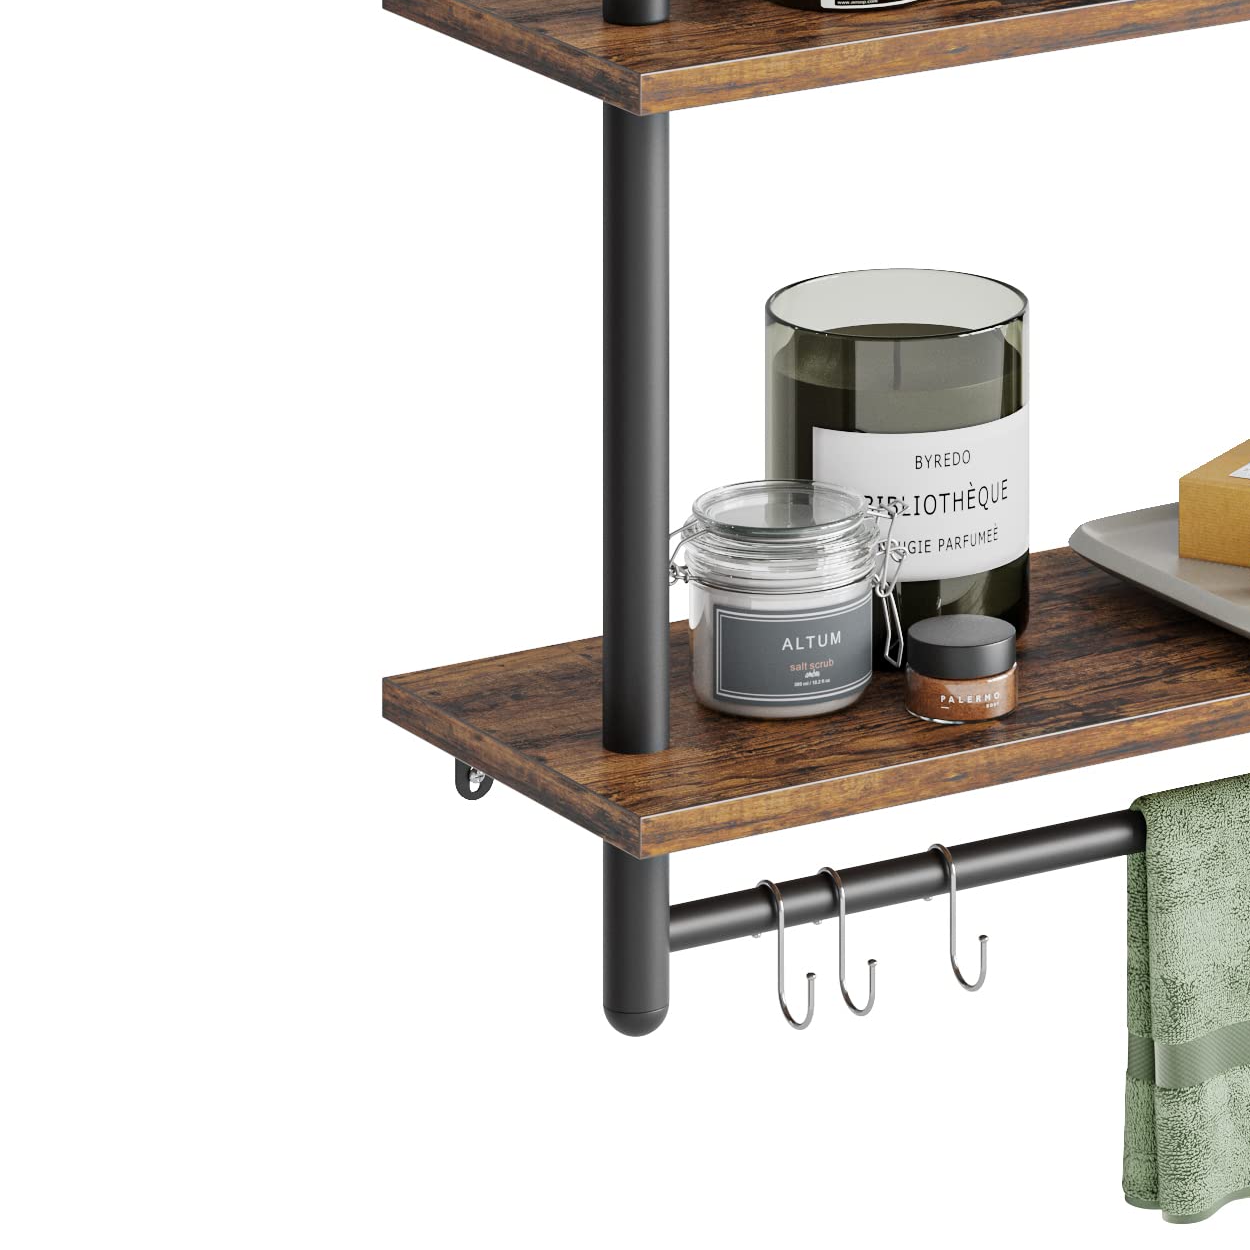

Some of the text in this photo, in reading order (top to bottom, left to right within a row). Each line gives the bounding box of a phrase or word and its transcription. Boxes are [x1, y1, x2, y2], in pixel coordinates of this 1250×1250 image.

[915, 450, 972, 470] BYREDO
[782, 630, 841, 651] ALTUM
[790, 658, 834, 672] salt scrub
[940, 692, 1000, 704] PALERMO
